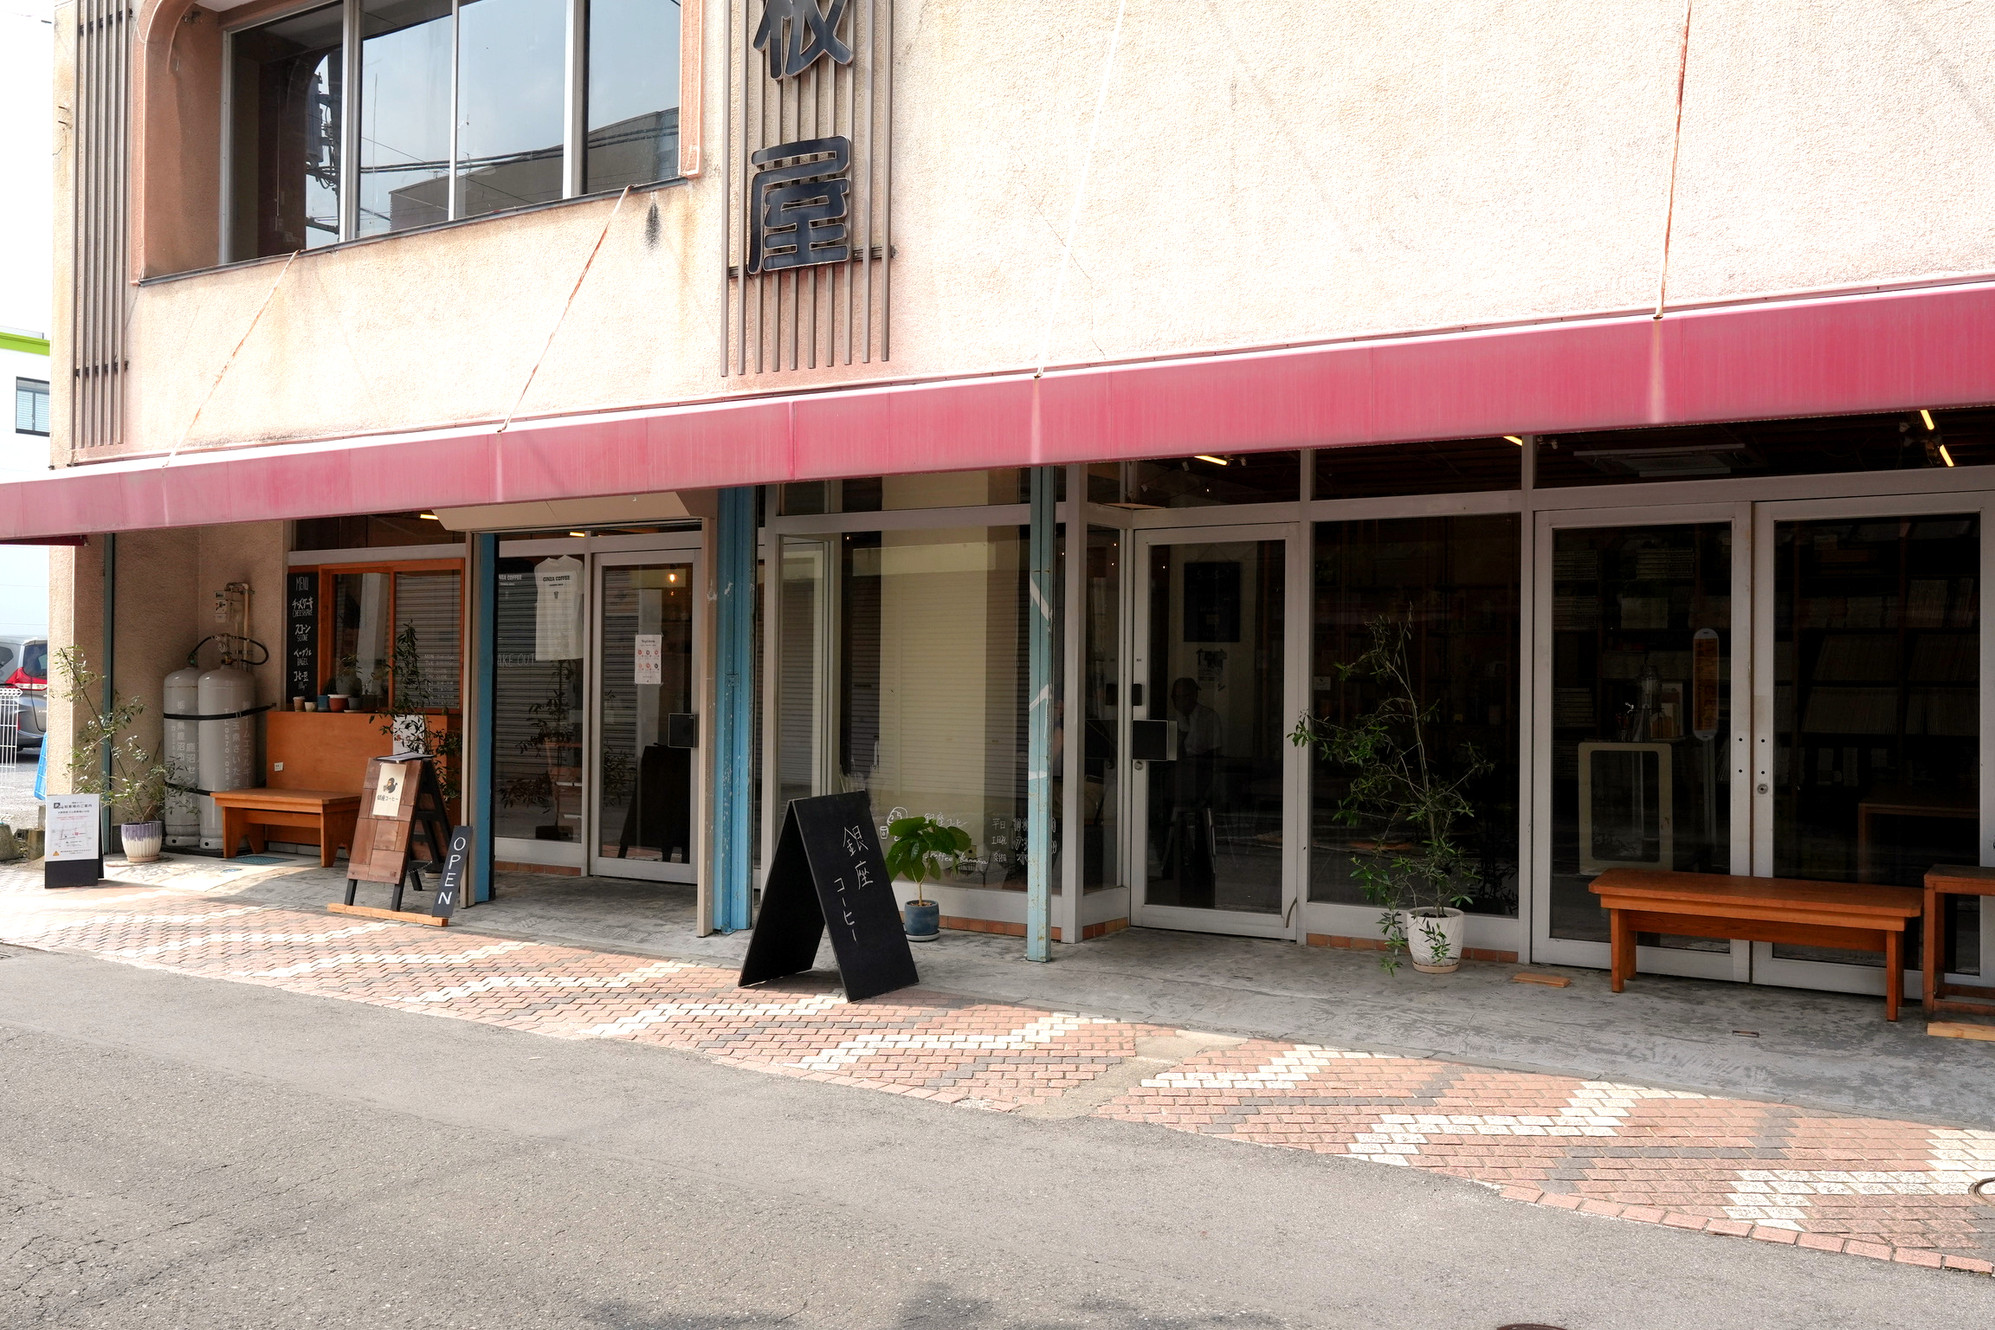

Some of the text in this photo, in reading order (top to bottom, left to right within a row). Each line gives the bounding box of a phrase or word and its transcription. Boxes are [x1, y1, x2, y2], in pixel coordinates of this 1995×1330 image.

[497, 653, 513, 667] AKE
[437, 836, 467, 905] OPEN
[842, 825, 874, 890] 銀座
[833, 877, 858, 942] コーヒー
